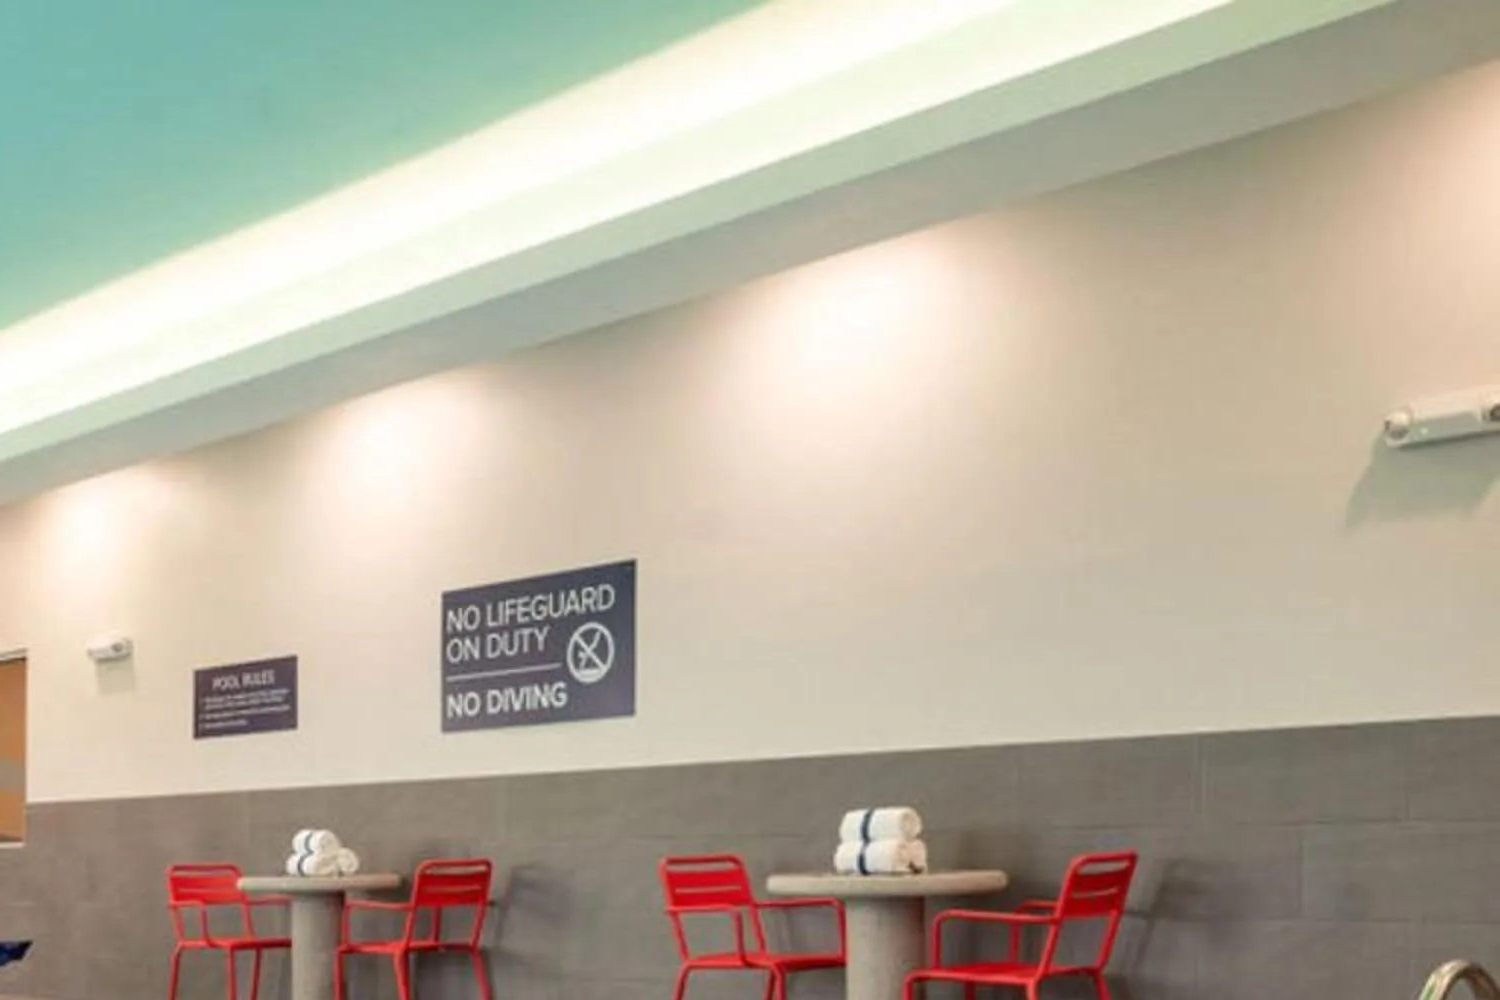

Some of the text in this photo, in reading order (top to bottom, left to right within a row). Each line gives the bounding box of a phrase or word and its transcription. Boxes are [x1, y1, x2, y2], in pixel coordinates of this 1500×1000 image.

[446, 584, 616, 634] NO LIFEGUARD
[446, 626, 550, 664] ON DUTY
[446, 681, 568, 719] NO DIVING
